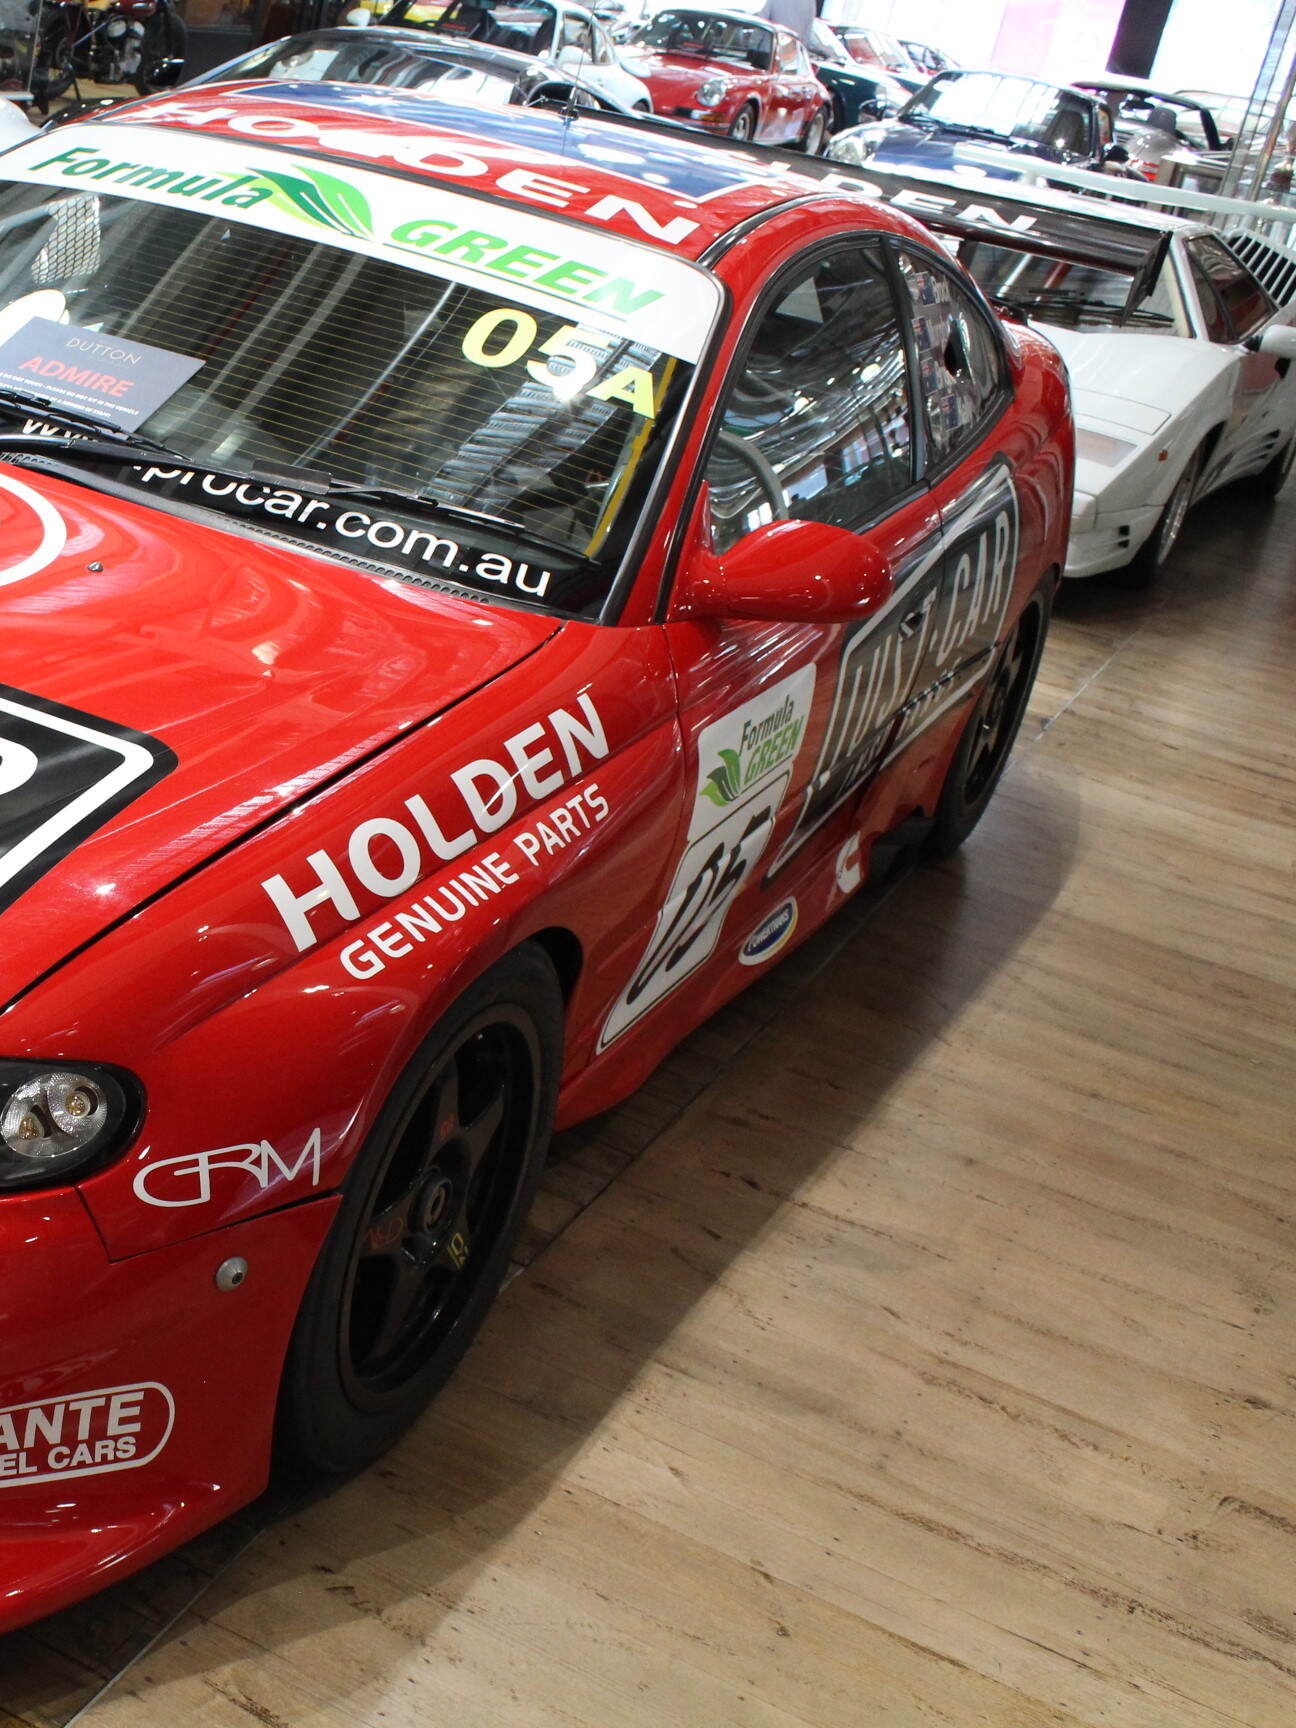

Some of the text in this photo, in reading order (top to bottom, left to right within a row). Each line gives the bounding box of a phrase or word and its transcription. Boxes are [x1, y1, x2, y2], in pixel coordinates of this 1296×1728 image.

[28, 147, 273, 209] Formula
[390, 219, 665, 315] GREEN
[18, 356, 135, 397] ADMIRE
[66, 337, 142, 365] DUTTON
[739, 694, 794, 756] Formula
[744, 714, 805, 785] GREEN
[261, 693, 610, 952] HOLDEN
[340, 783, 610, 980] GENUINE PARTS
[47, 1435, 137, 1469] CARS
